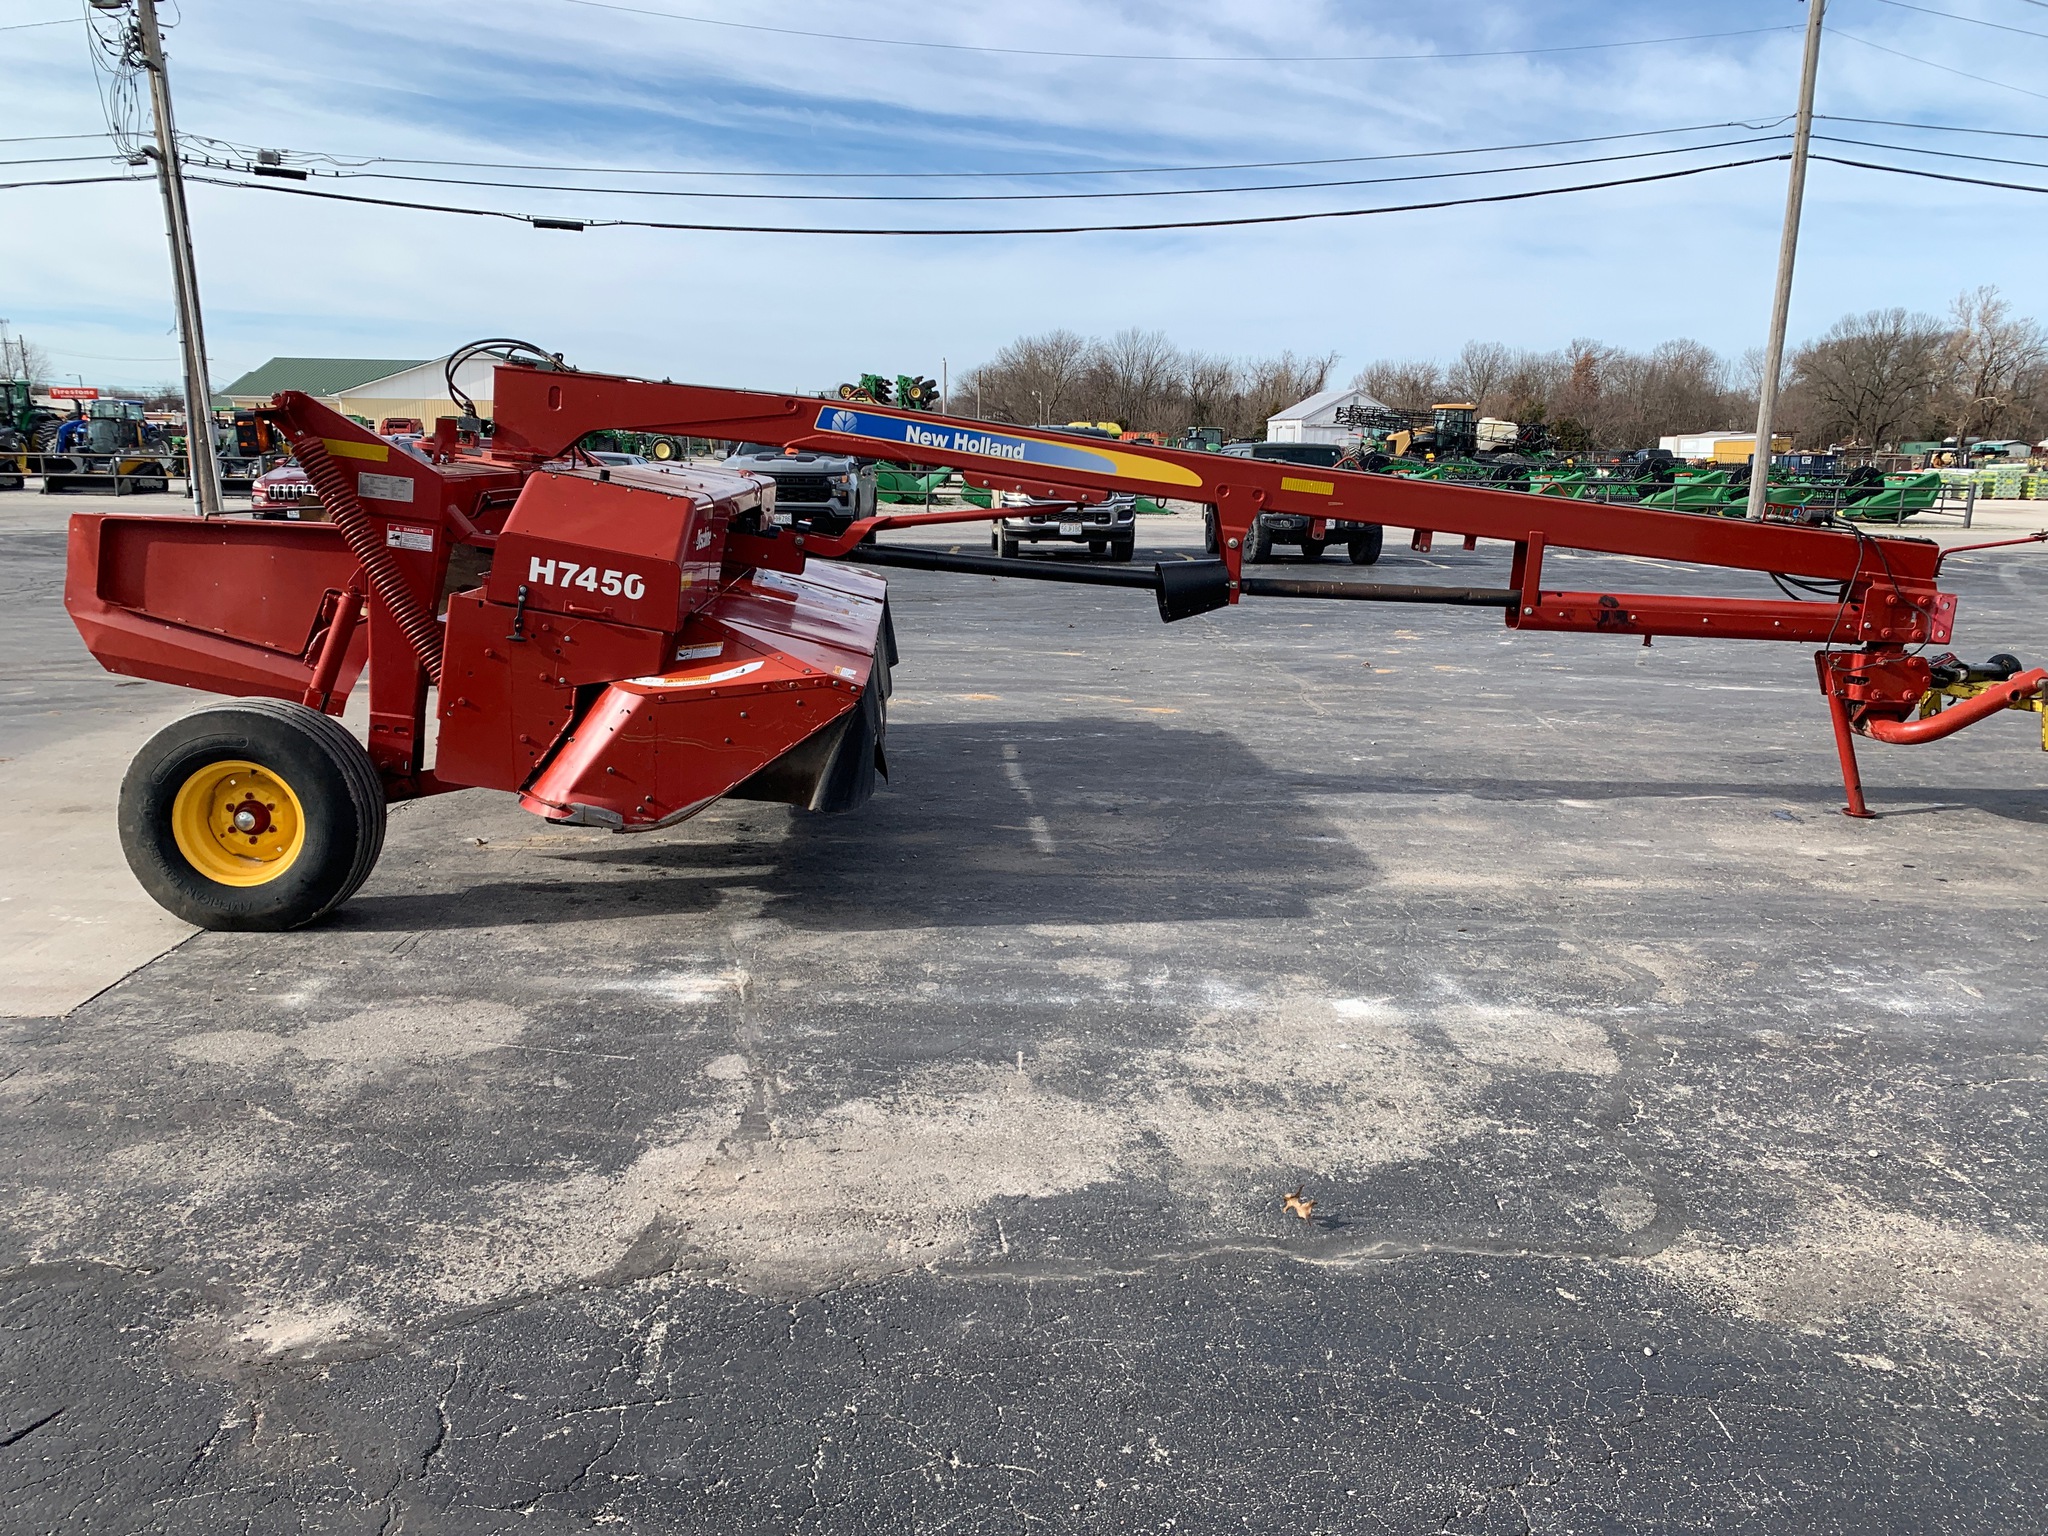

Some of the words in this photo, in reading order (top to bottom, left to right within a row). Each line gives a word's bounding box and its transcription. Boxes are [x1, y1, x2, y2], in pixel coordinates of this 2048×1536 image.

[905, 425, 949, 448] New
[953, 432, 1026, 459] Holland
[528, 556, 645, 600] H7450
